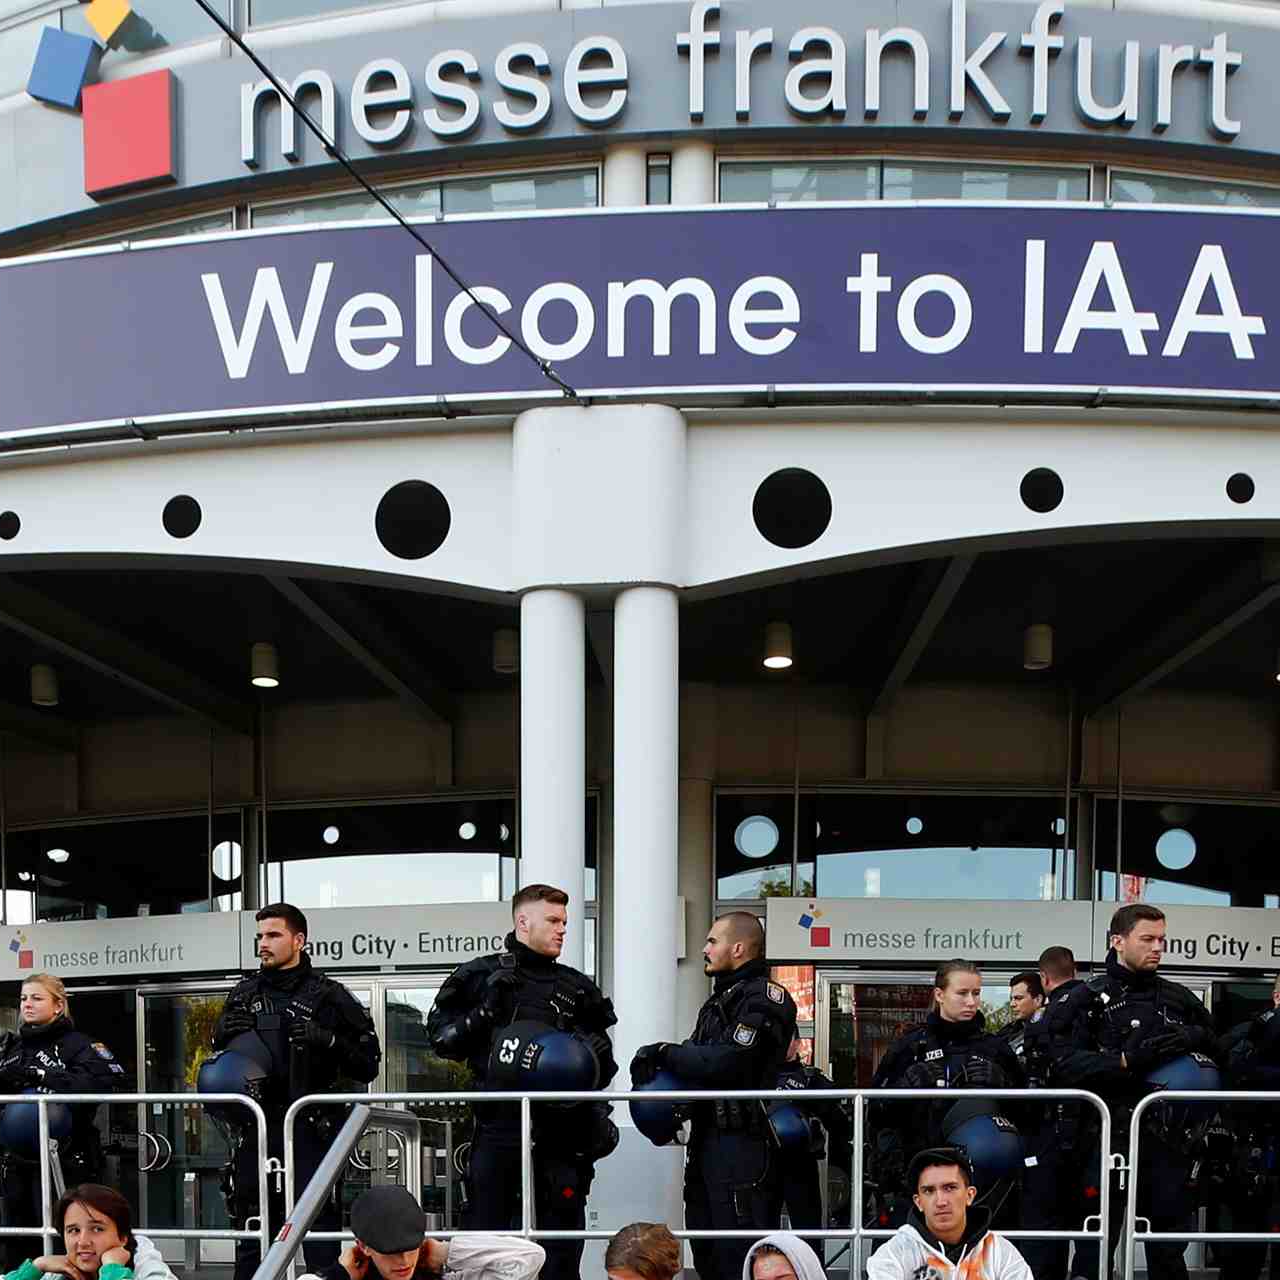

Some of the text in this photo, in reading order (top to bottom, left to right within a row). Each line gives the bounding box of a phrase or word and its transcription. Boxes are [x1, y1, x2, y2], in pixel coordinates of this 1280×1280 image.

[240, 0, 1243, 168] messe frankfurt
[201, 238, 1267, 380] Welcome to IAA
[352, 933, 396, 959] City
[843, 926, 1023, 950] messe frankfurt
[1206, 934, 1249, 961] City
[42, 942, 183, 969] messe frankfurt
